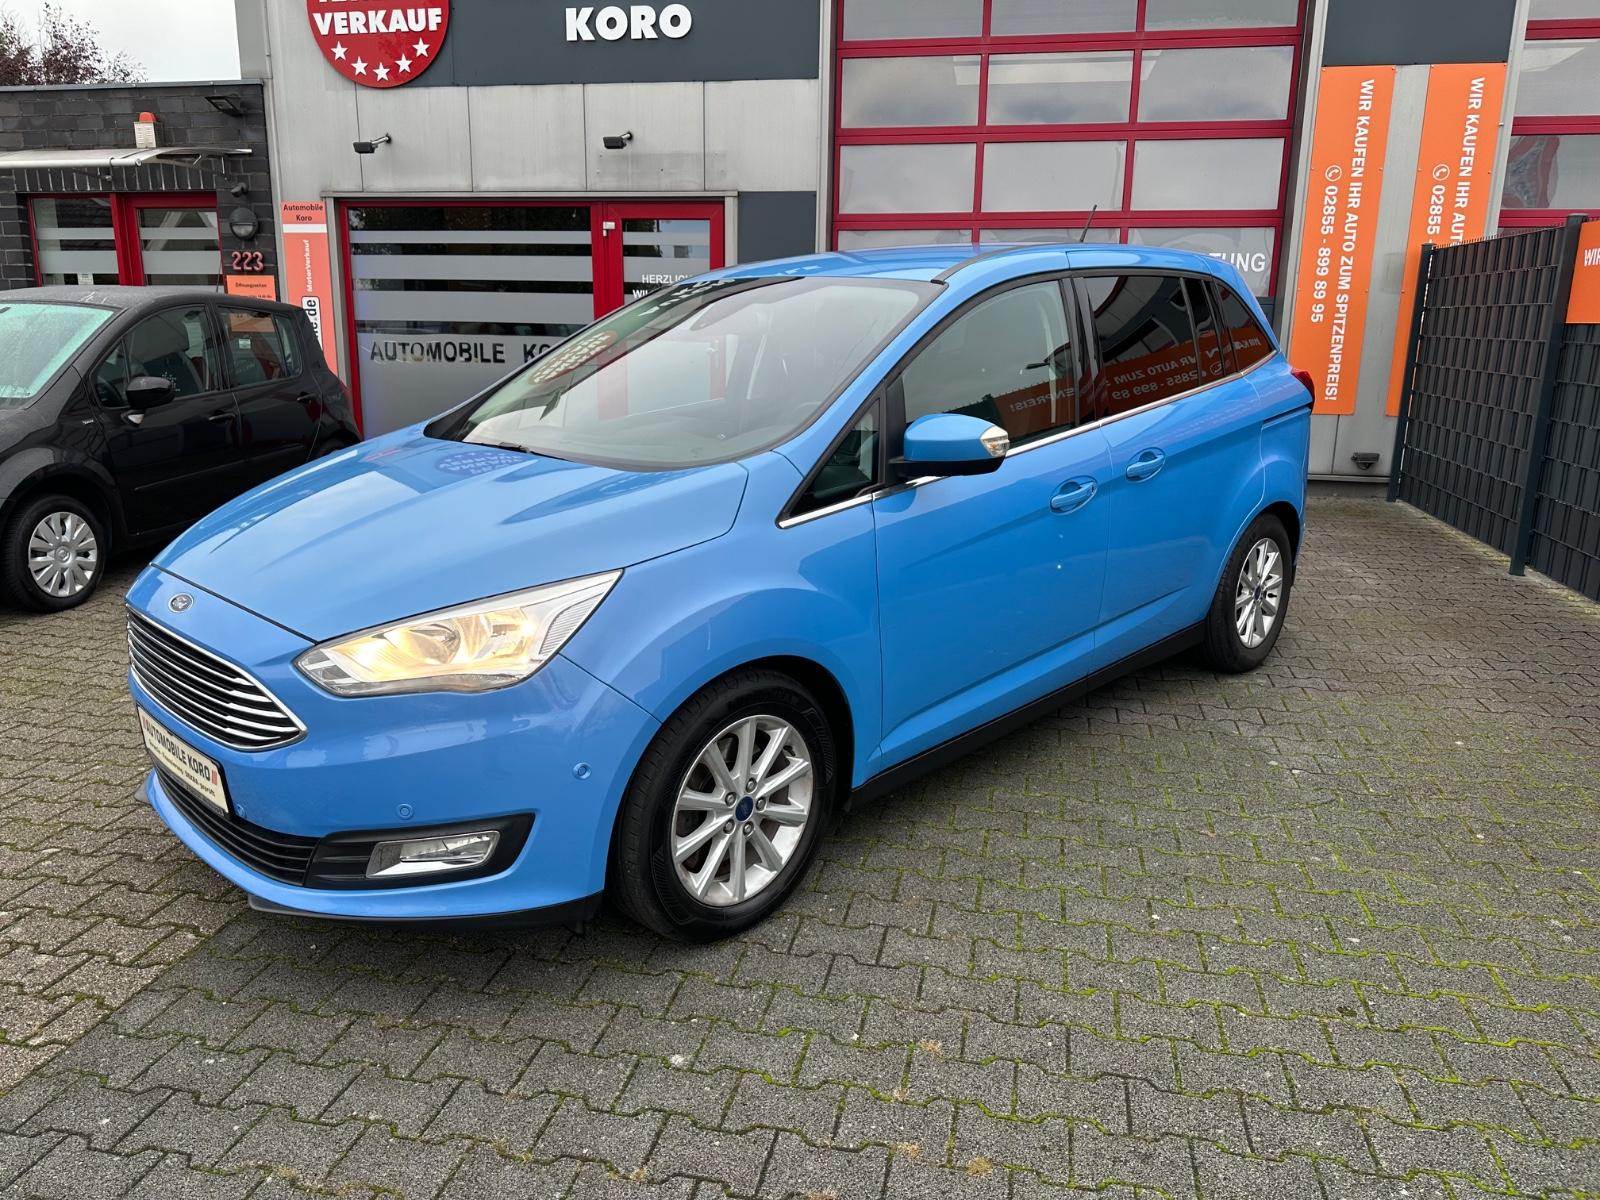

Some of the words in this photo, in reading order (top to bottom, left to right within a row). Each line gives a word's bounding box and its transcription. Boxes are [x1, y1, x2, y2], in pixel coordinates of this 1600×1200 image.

[312, 8, 442, 36] VERKAUF
[565, 3, 692, 42] KORO
[1358, 79, 1375, 111] WIR
[1468, 77, 1485, 110] WIR
[1350, 115, 1370, 178] KAUFEN
[1459, 114, 1480, 177] KAUFEN
[283, 203, 323, 212] Automobile
[1320, 185, 1338, 235] 02855
[1347, 182, 1363, 208] IHR
[1427, 185, 1446, 235] 02855
[1454, 181, 1471, 208] IHR
[296, 214, 313, 222] Koro
[1342, 212, 1359, 252] AUTO
[1450, 212, 1466, 246] AUT
[231, 251, 264, 271] 223
[1316, 247, 1332, 277] 899
[1337, 255, 1354, 290] ZUM
[1313, 280, 1328, 299] 89
[1311, 303, 1325, 323] 95
[370, 341, 506, 364] AUTOMOBILE
[1324, 293, 1349, 401] SPITZENPREIS!
[187, 753, 211, 782] KORO
